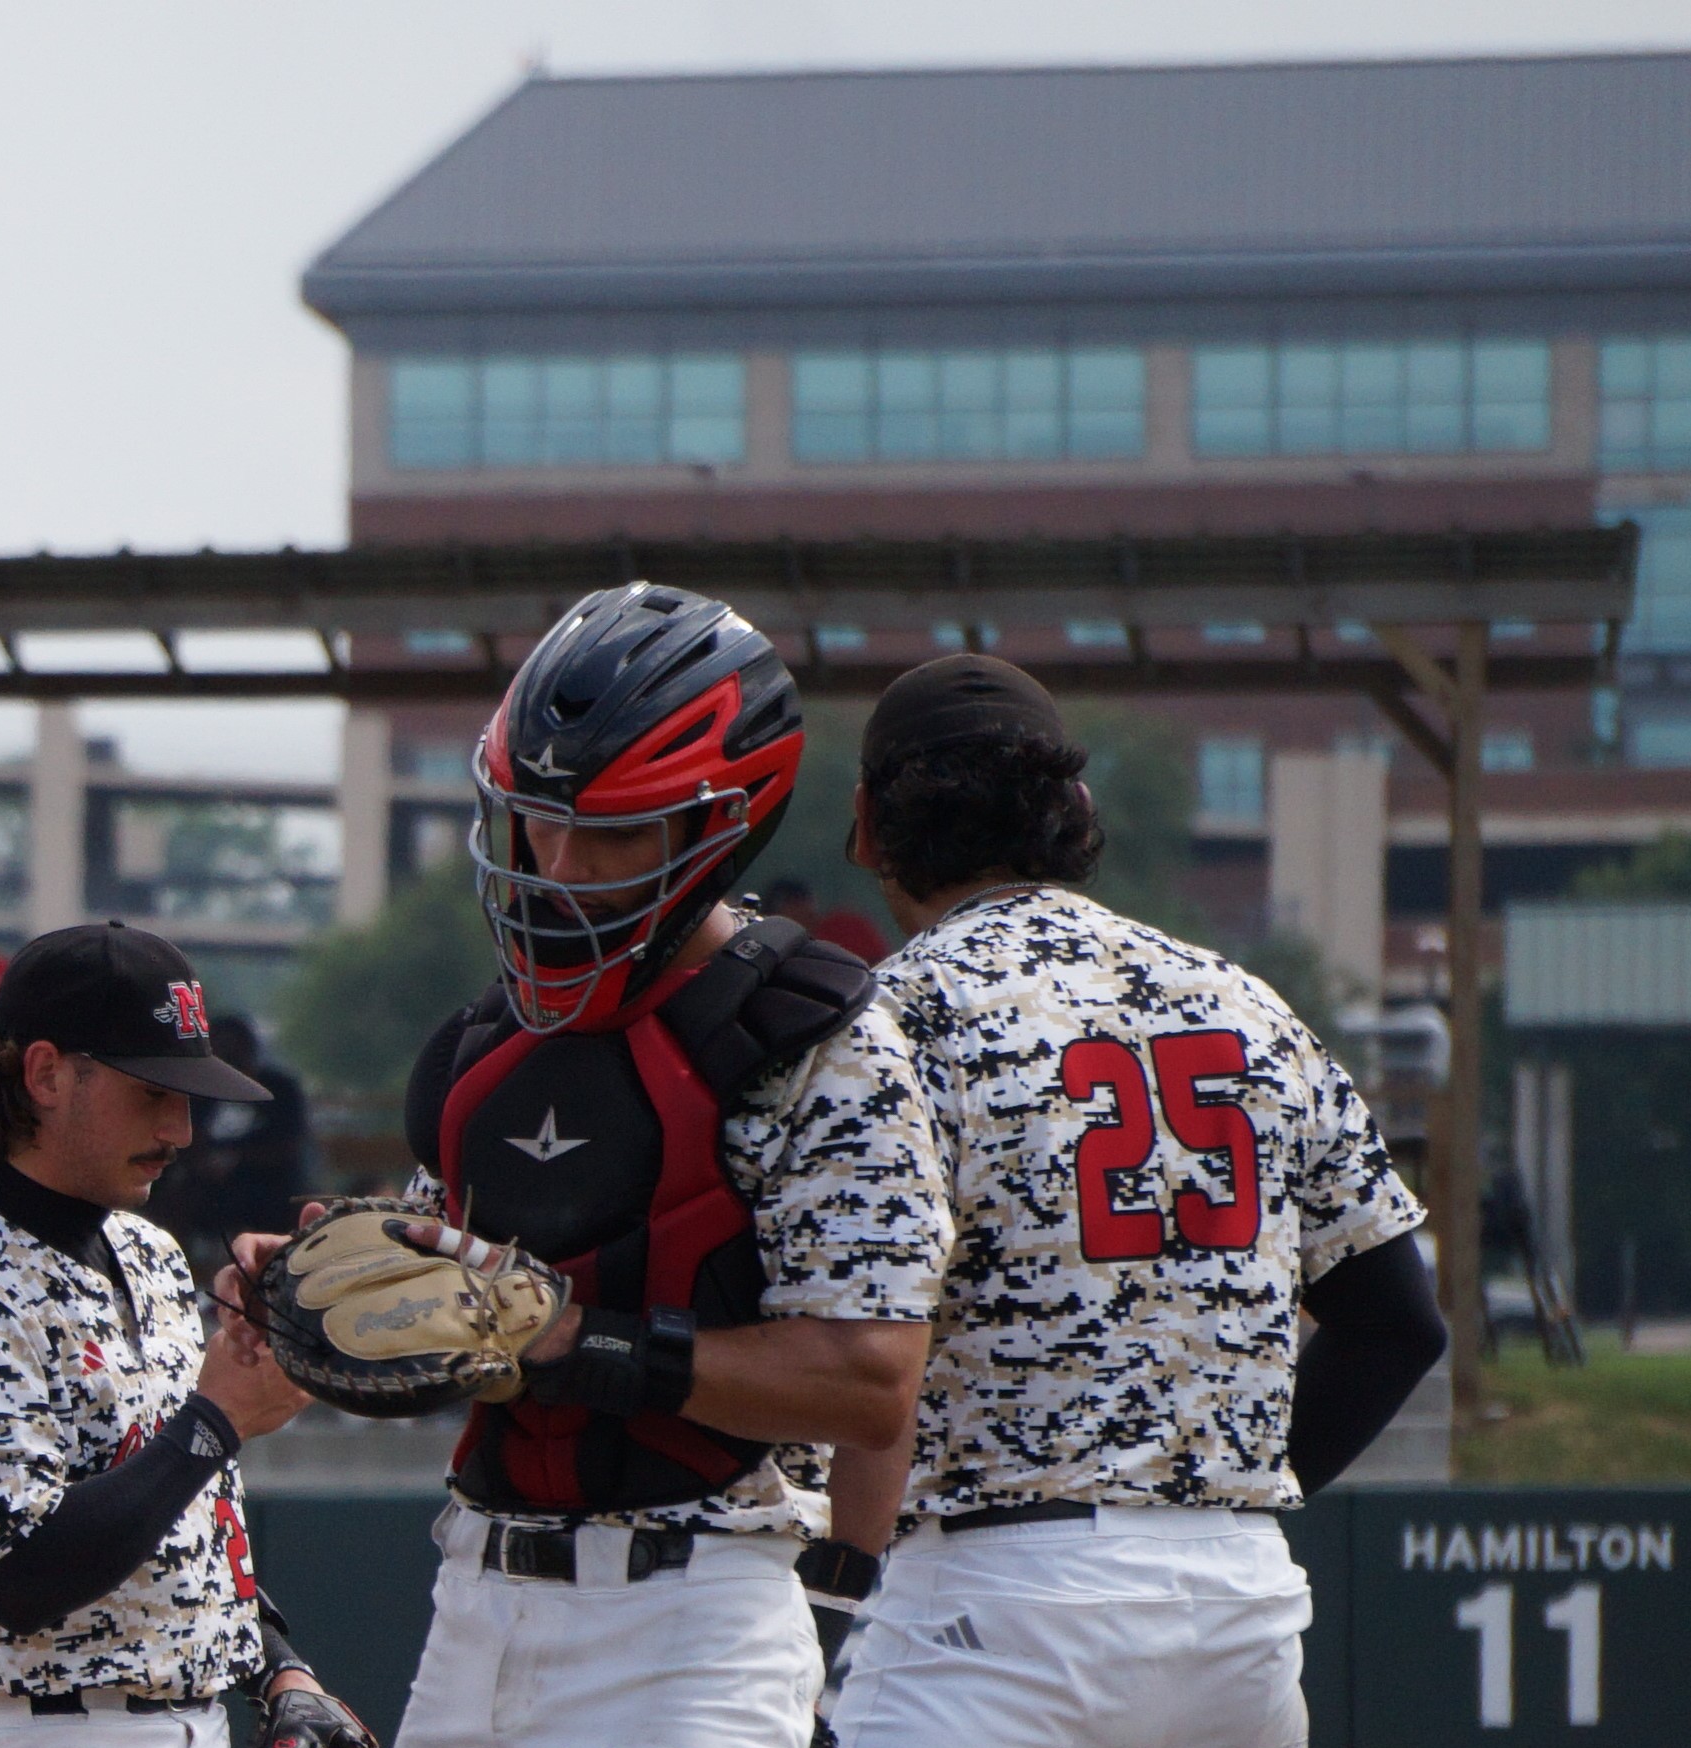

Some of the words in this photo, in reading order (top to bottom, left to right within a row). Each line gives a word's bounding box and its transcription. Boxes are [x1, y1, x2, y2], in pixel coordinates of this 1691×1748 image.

[1060, 1030, 1261, 1263] 25
[1403, 1522, 1674, 1572] HAMILTON
[1456, 1582, 1601, 1729] 11
